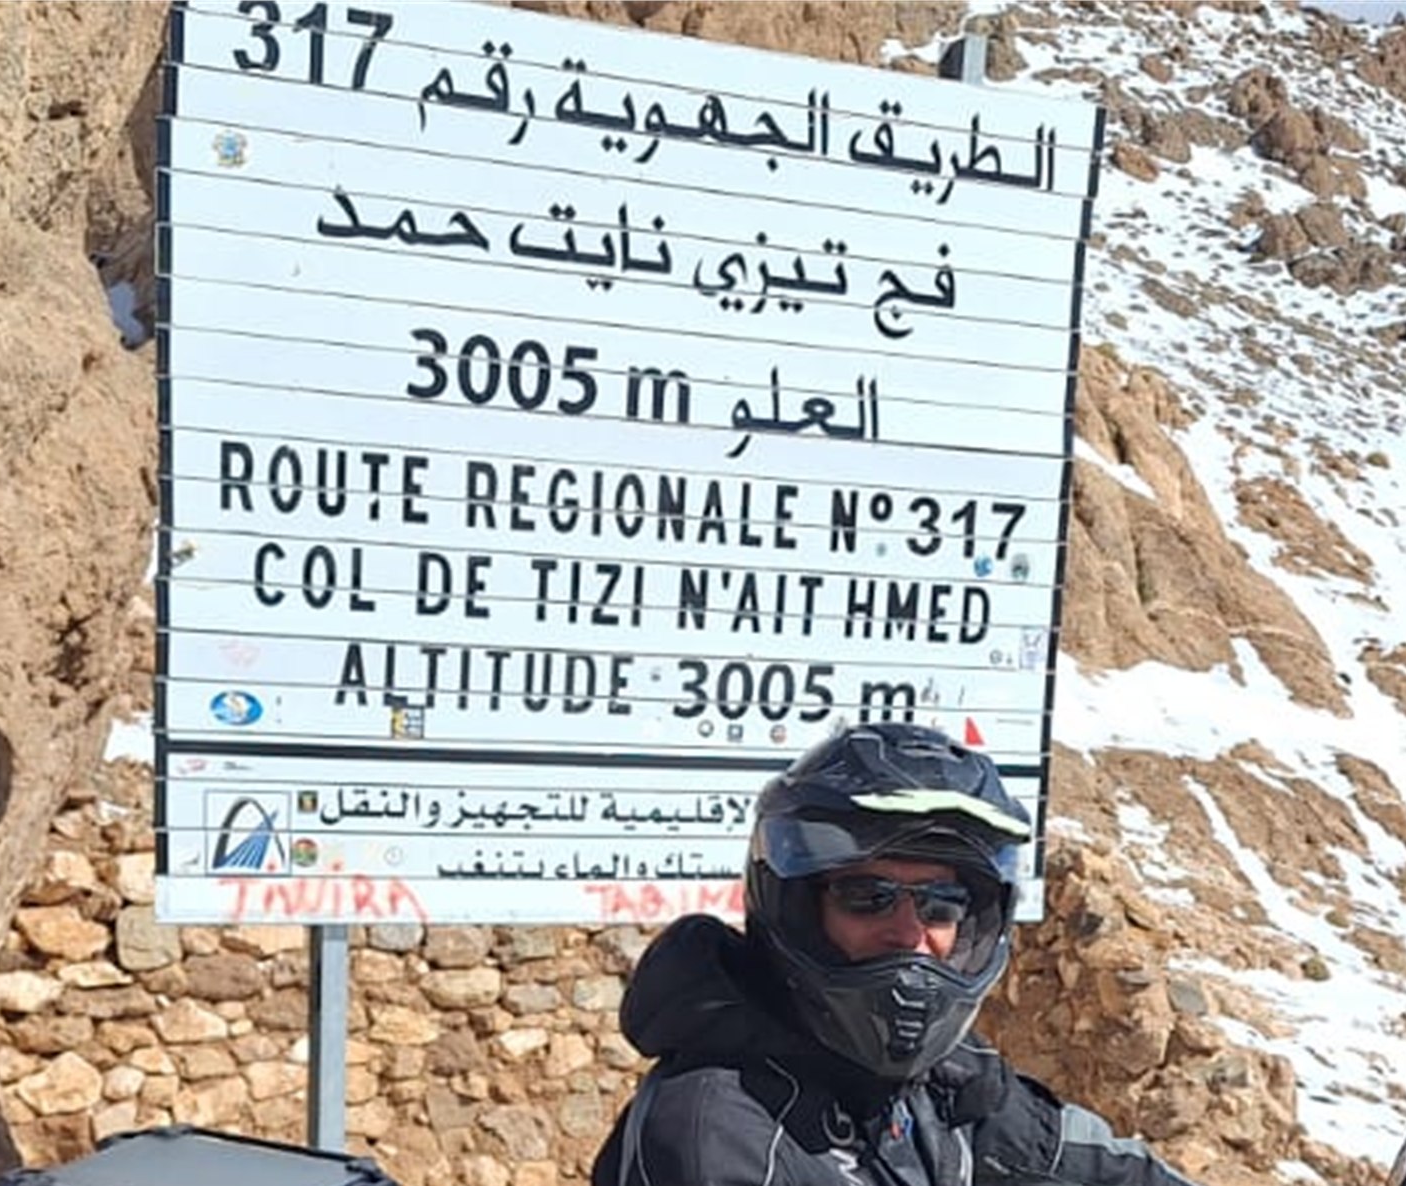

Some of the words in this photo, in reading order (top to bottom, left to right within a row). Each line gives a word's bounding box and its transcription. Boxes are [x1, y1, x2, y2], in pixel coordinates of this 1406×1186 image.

[234, 0, 392, 91] 317
[417, 40, 536, 145] رقم
[554, 57, 830, 170] الجهوية
[849, 101, 1055, 204] الطريق
[316, 185, 490, 251] حمد
[510, 205, 671, 289] نايت
[693, 233, 847, 313] تيزي
[874, 245, 955, 339] فج
[407, 329, 597, 415] 3005
[627, 367, 690, 424] m
[728, 366, 879, 459] العلو
[221, 441, 428, 523] ROUTE
[467, 461, 798, 549] REGIONALE
[255, 543, 375, 612] COL
[417, 553, 491, 618] DE
[532, 560, 644, 626] TIZI
[678, 569, 823, 635] N'AIT
[845, 579, 990, 644] HMED
[336, 644, 632, 714] ALTITUDE
[672, 660, 835, 722] 3005
[858, 681, 916, 723] m
[319, 788, 441, 828] والنقل
[445, 790, 589, 829] للتجهيز
[600, 793, 752, 832] لإقليمية
